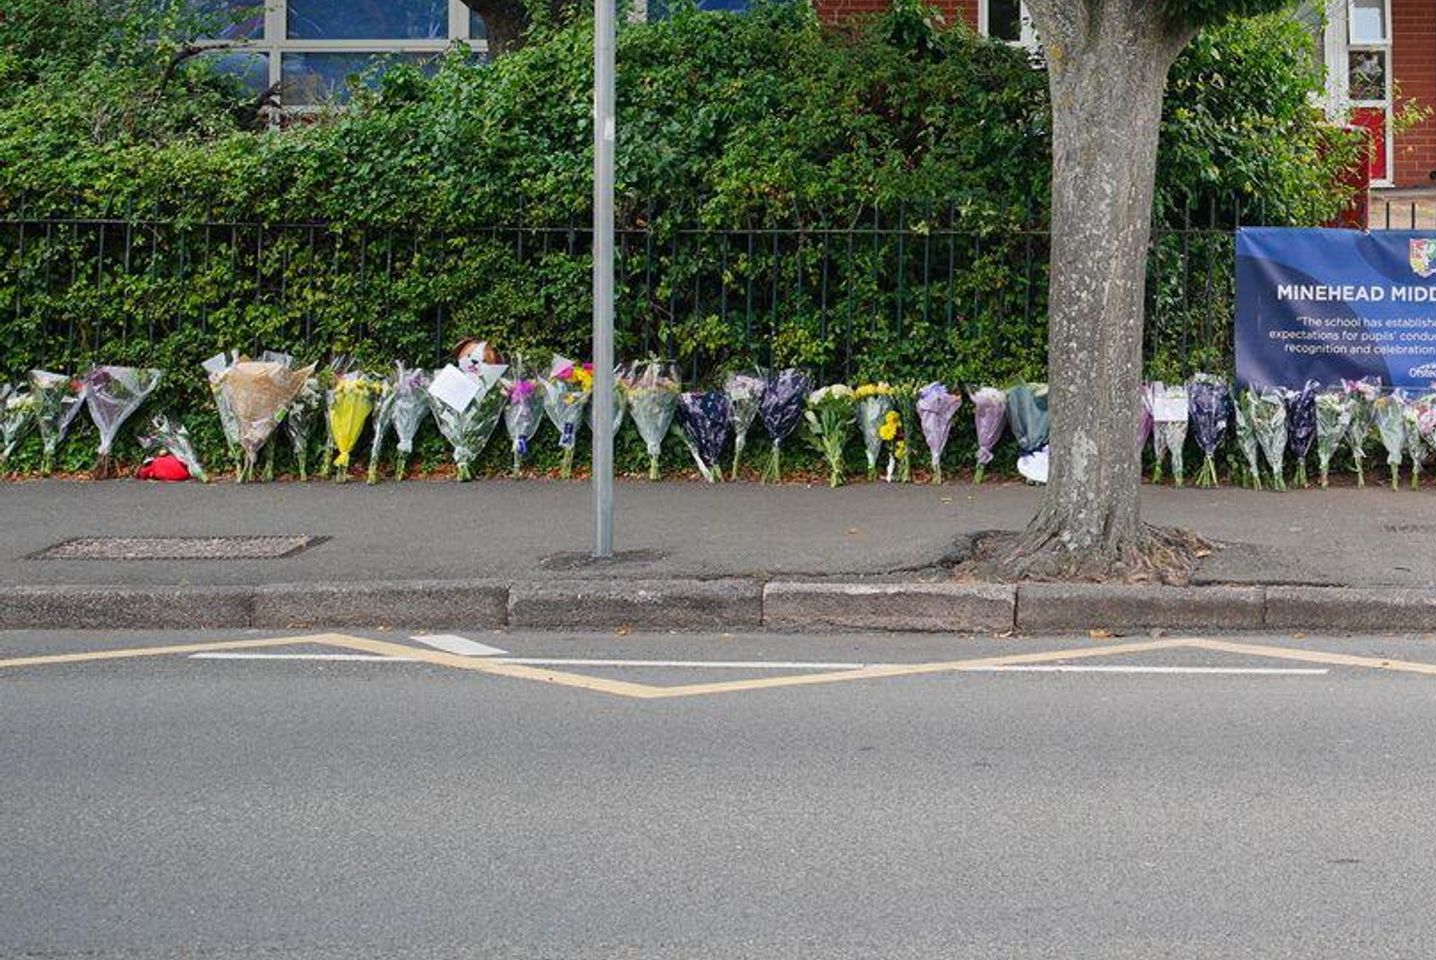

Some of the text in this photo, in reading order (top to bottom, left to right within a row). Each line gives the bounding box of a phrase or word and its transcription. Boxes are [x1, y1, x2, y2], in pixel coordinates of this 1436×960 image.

[1277, 285, 1385, 302] MINEHEAD
[1325, 317, 1361, 327] school
[1363, 318, 1383, 327] has
[1269, 330, 1340, 342] expectations
[1342, 331, 1358, 341] for
[1284, 343, 1348, 356] recognition
[1349, 344, 1371, 354] and
[1374, 344, 1436, 355] celebration
